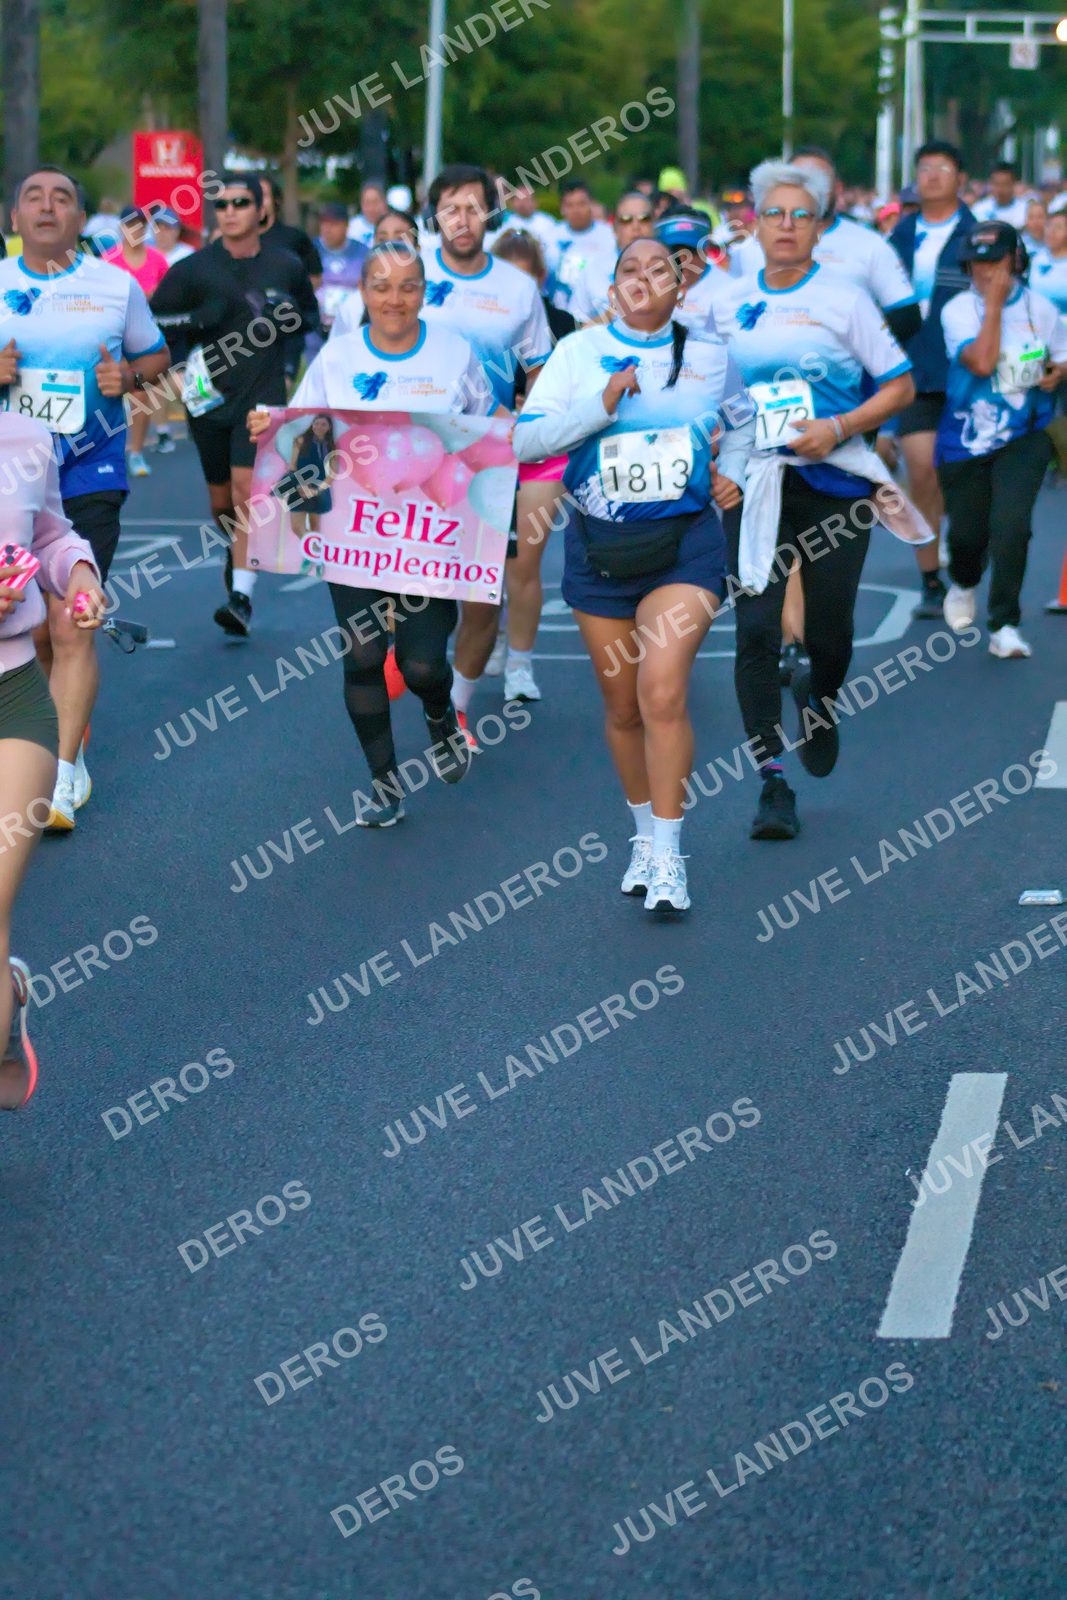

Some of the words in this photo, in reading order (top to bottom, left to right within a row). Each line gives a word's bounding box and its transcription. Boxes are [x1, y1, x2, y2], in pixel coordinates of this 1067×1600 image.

[19, 395, 73, 424] 847
[608, 458, 690, 493] 1813
[349, 498, 461, 547] Feliz
[303, 535, 499, 585] Cumpleaños
